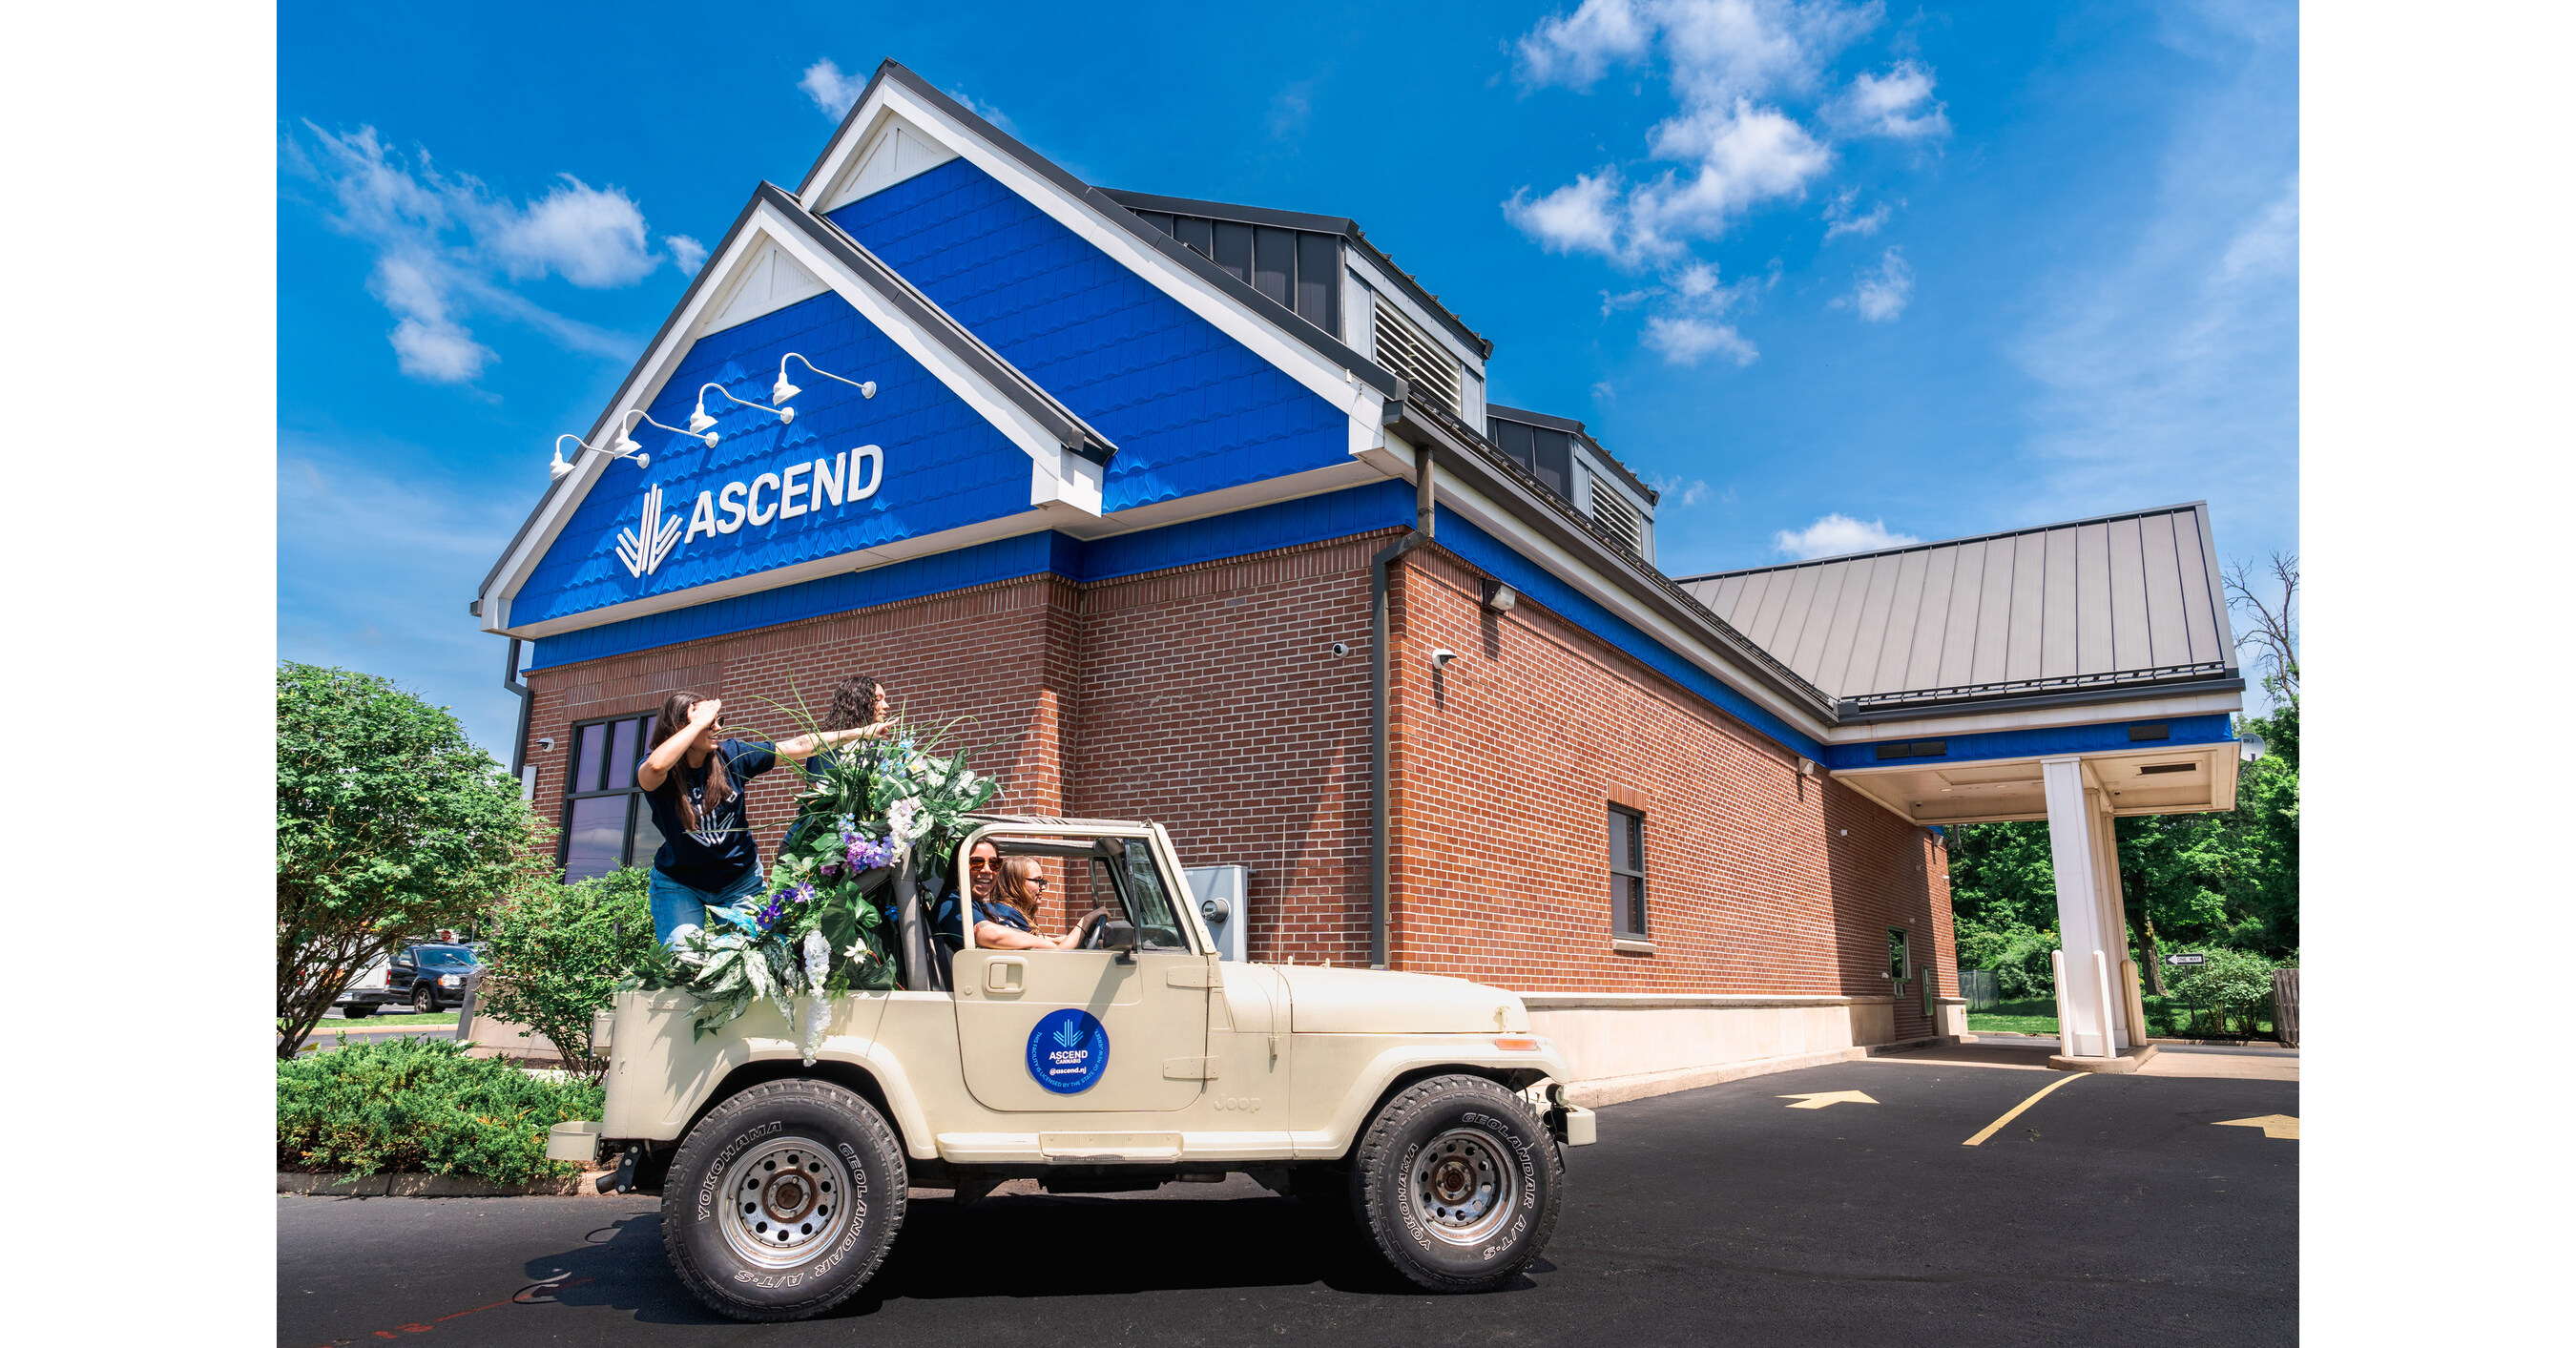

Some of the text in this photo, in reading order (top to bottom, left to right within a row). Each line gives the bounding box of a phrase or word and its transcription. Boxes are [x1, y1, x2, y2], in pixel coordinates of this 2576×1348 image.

[683, 444, 884, 544] ASCEND
[1033, 1031, 1043, 1044] THIS
[1031, 1044, 1040, 1067] FACILITY
[1049, 1050, 1089, 1060] ASCEND
[1049, 1067, 1087, 1076] @ascend.nj
[1080, 1069, 1095, 1084] STATE
[1092, 1063, 1100, 1071] OF
[1039, 1071, 1063, 1088] LICENSED
[698, 1121, 782, 1221] YOKOHAMA
[1462, 1112, 1535, 1210] GEOLANDAR
[1398, 1142, 1431, 1252] YOKOHAMA
[814, 1142, 868, 1277] GEOLANDAR
